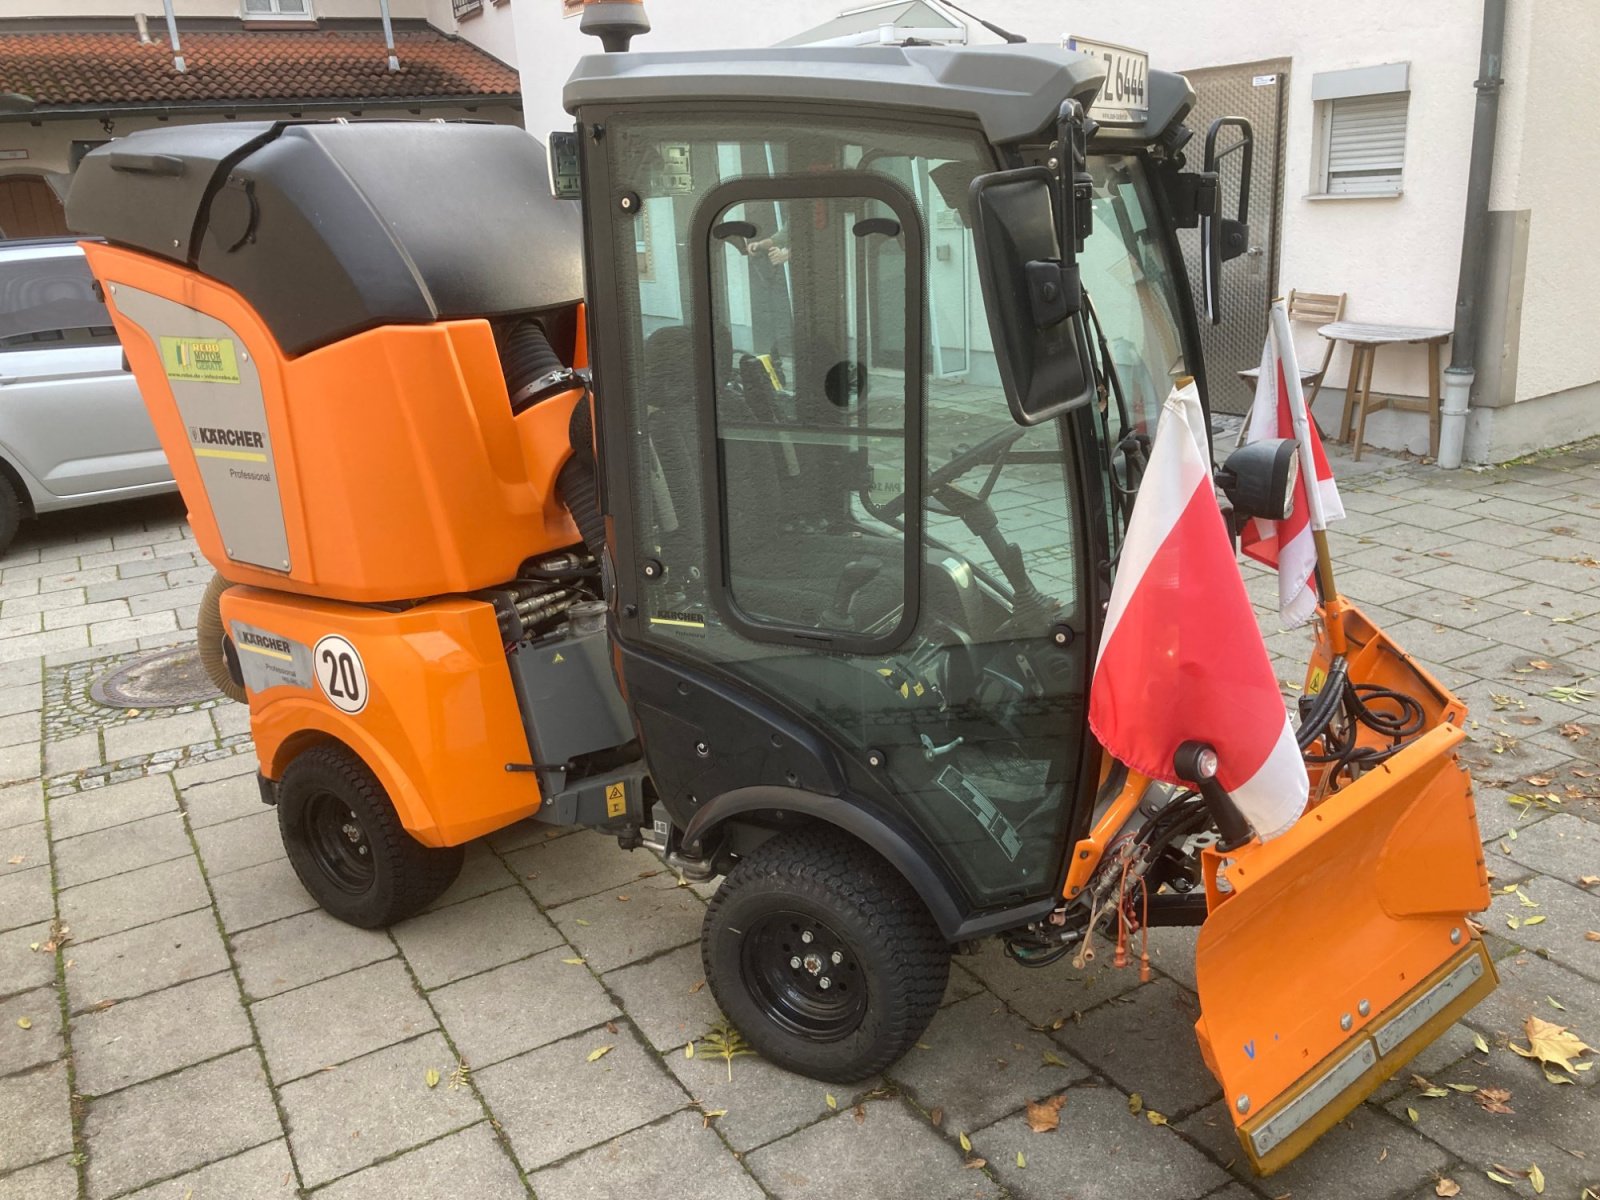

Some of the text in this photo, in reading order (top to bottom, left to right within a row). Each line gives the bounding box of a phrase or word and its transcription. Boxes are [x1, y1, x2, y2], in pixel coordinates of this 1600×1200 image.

[1116, 55, 1144, 105] 6444
[192, 343, 220, 352] REBO
[194, 351, 221, 361] MOTOR
[199, 427, 264, 448] KÄRCHER
[229, 467, 271, 481] Professional
[242, 632, 291, 653] KÄRCHER
[322, 649, 359, 701] 20
